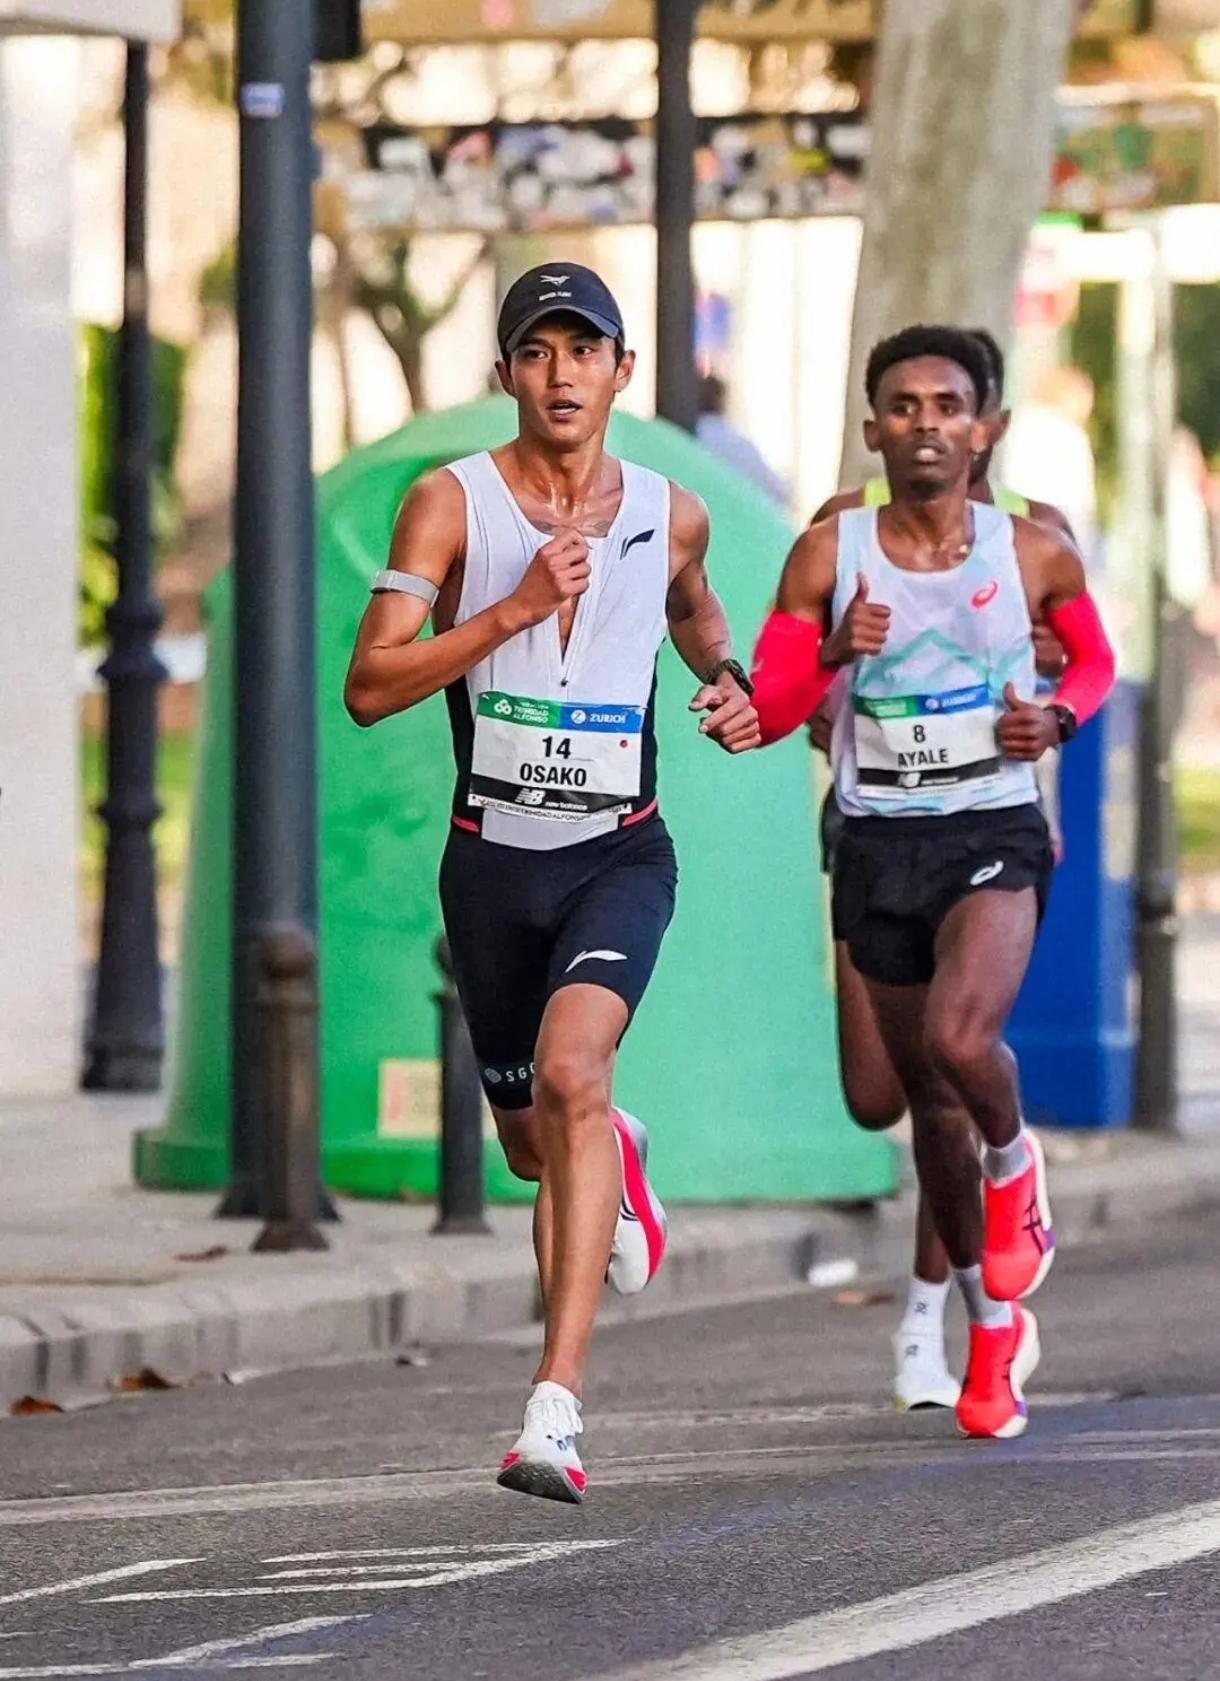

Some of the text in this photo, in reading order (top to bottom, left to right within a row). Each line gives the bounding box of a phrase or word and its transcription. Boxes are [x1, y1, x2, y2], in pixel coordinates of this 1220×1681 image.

[913, 724, 926, 743] 8
[542, 736, 571, 759] 14
[897, 749, 948, 768] AYALE
[519, 762, 587, 786] OSAKO
